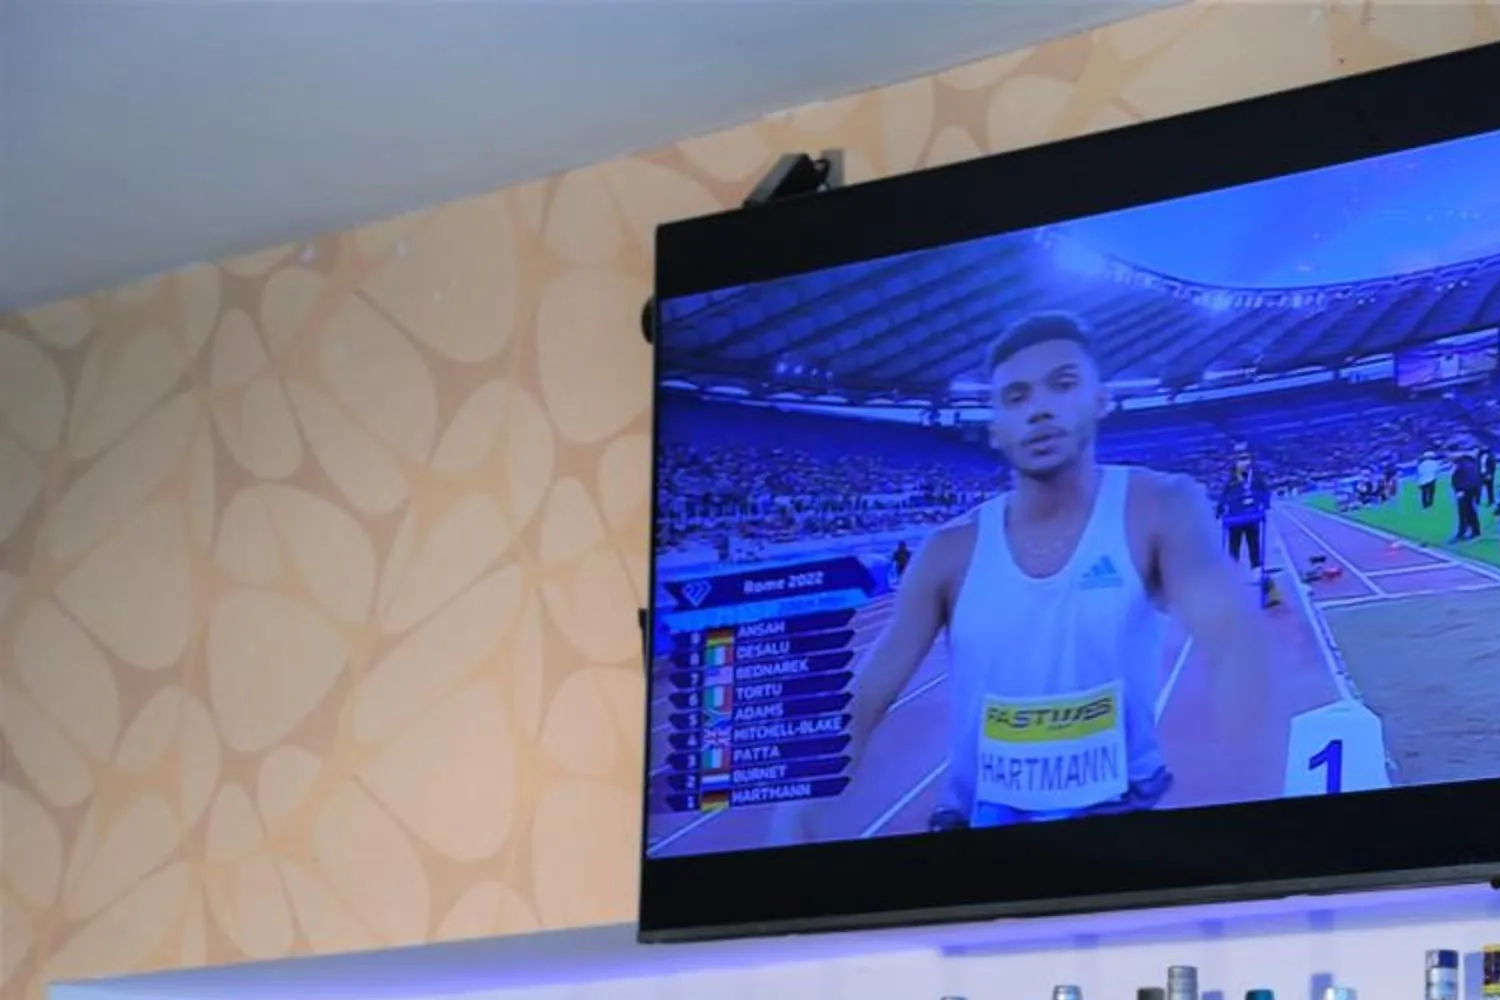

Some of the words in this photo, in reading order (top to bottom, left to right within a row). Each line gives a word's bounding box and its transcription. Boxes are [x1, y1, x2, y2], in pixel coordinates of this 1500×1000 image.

[743, 578, 785, 594] Rome
[787, 571, 825, 588] 2022
[737, 621, 786, 638] ANSAH
[736, 640, 791, 659] DESALU
[736, 658, 810, 679] BEDNAREK
[736, 683, 783, 700] TORTU
[735, 702, 785, 720] ADAMS
[733, 716, 843, 742] MITCHELL-BLAKE
[733, 745, 781, 762] PATTA
[733, 764, 788, 783] BURNET
[981, 742, 1118, 791] HARTMANN
[1308, 738, 1344, 794] 1
[732, 782, 812, 803] HARTMANN
